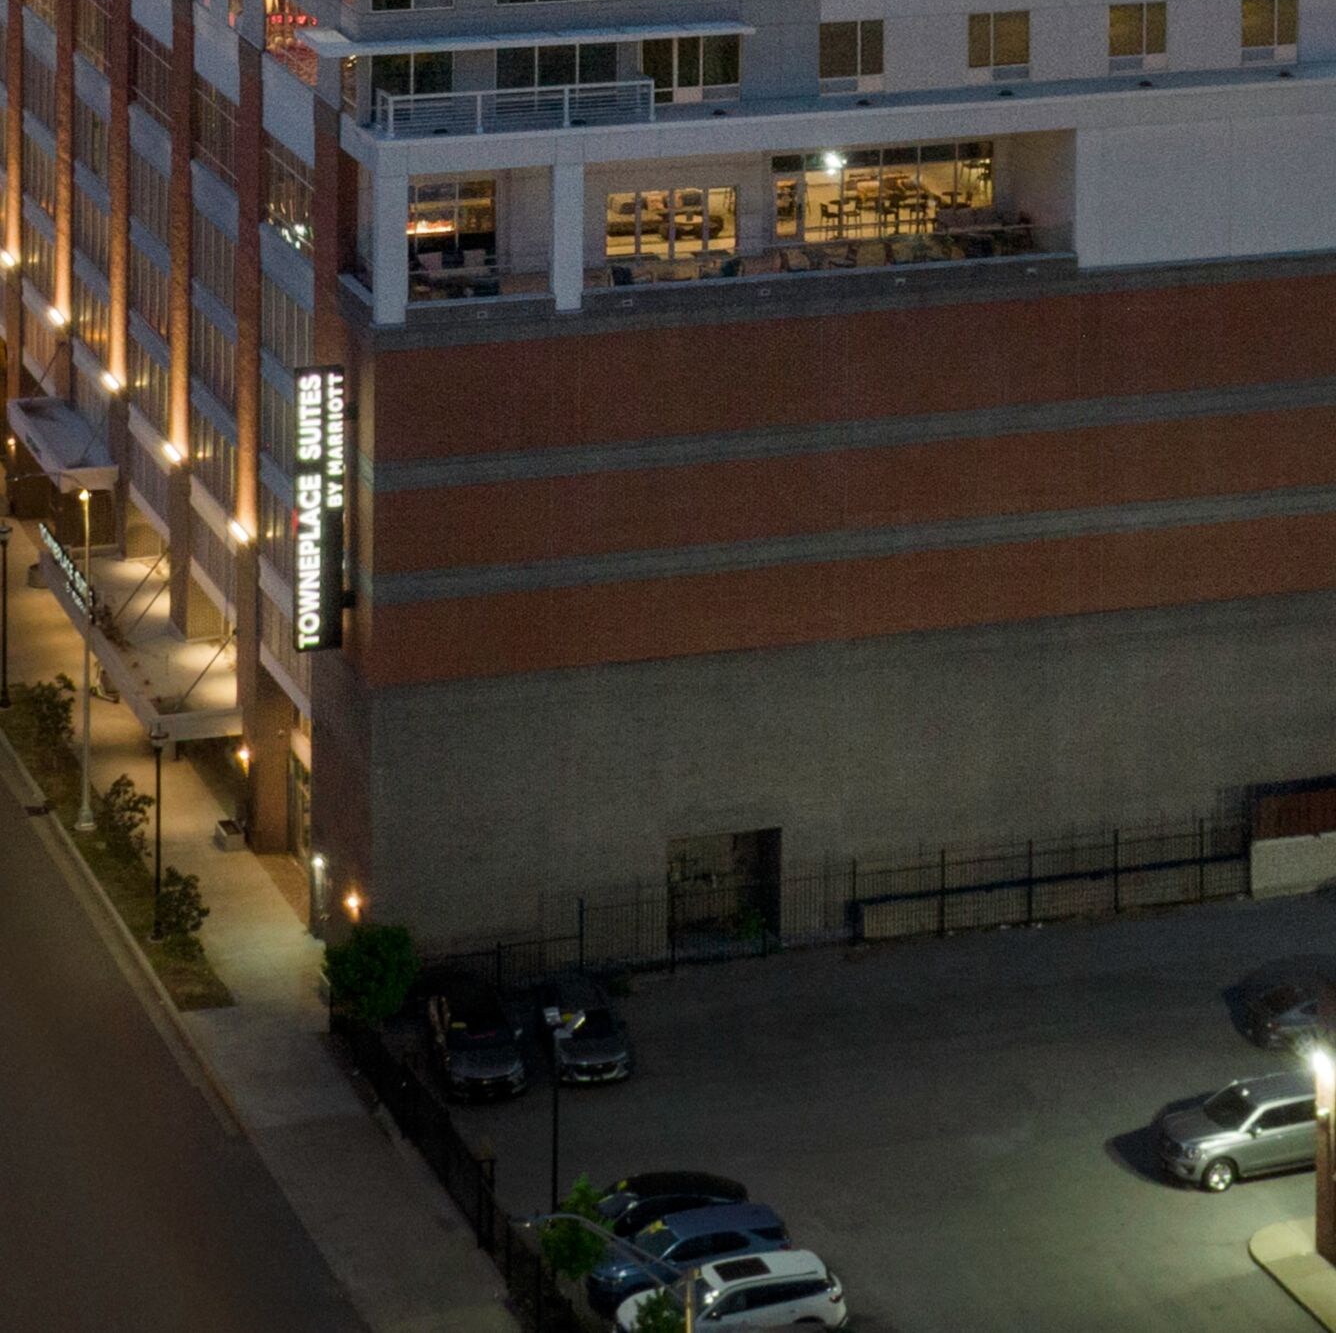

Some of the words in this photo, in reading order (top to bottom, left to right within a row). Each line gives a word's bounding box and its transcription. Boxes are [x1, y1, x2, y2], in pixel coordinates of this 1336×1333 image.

[298, 373, 322, 461] SUITES
[326, 373, 344, 476] MARRIOTT
[326, 481, 343, 508] BY
[297, 473, 322, 649] TOWNEPLACE
